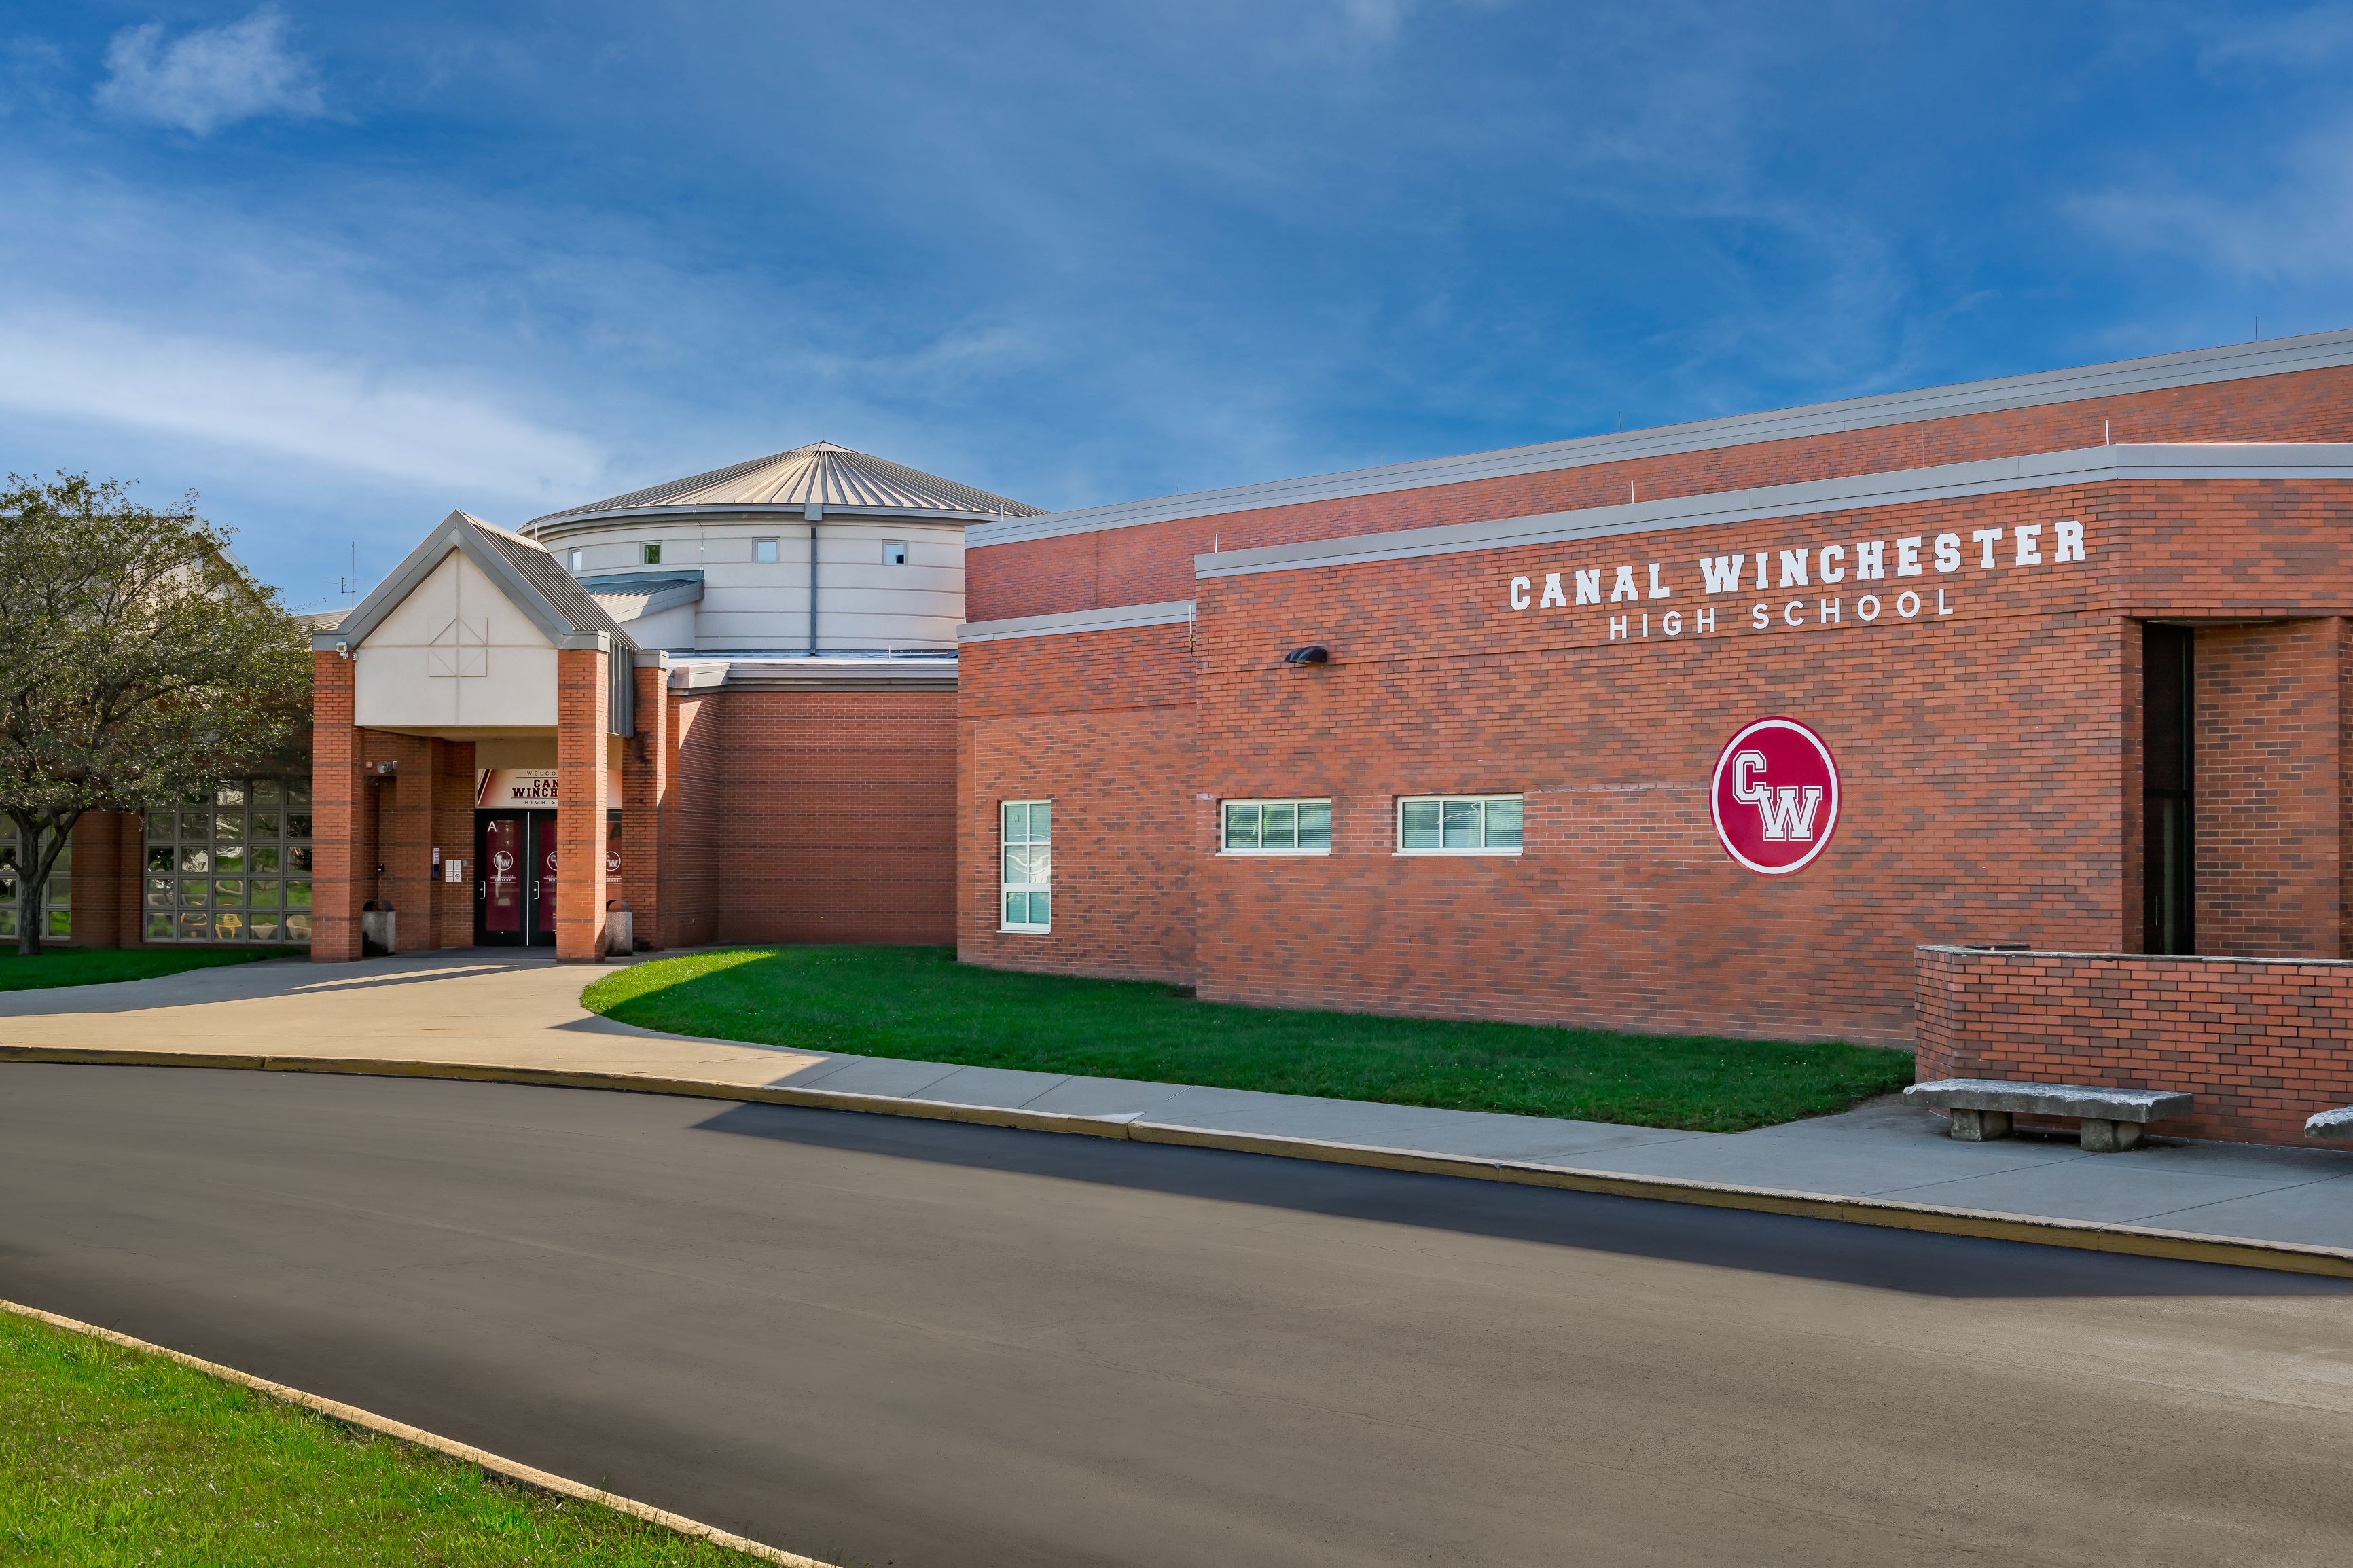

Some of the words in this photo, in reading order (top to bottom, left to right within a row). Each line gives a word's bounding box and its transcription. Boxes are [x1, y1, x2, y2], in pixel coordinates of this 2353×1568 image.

[1509, 562, 1671, 611] CANAL
[1698, 519, 2087, 595] WINCHESTER
[1609, 607, 1716, 641] HIGH
[1751, 587, 1954, 630] SCHOOL
[511, 788, 558, 797] WINCH
[533, 779, 558, 788] CAN
[1732, 750, 1823, 841] CW
[487, 820, 497, 832] A
